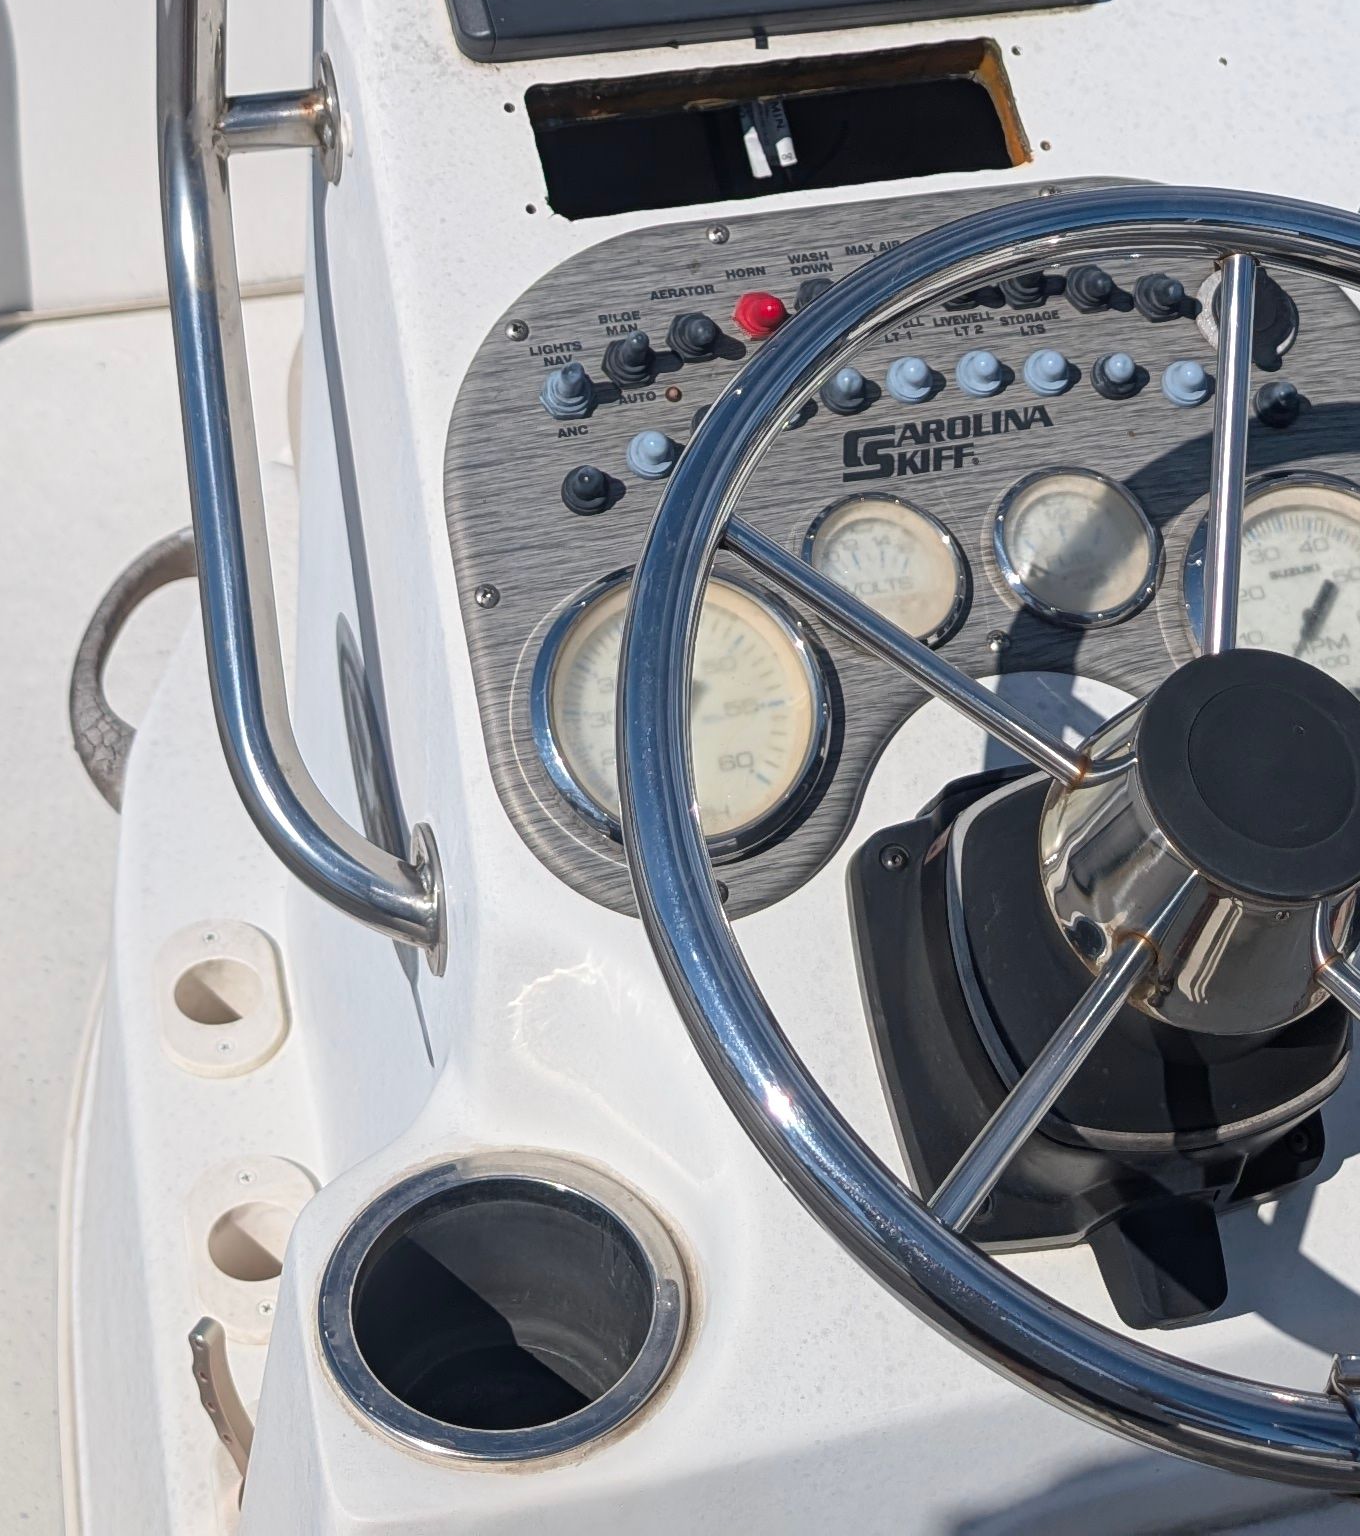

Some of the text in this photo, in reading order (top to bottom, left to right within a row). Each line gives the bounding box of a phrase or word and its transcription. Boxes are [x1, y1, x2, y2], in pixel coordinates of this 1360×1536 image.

[845, 242, 874, 256] MAX
[788, 251, 830, 265] WASH
[725, 265, 767, 281] HORN
[791, 262, 834, 277] DOWN
[649, 284, 717, 301] AERATOR
[598, 310, 641, 325] BILGE
[933, 311, 995, 328] LIVEWELL
[999, 310, 1061, 327] STORAGE
[606, 323, 639, 336] MAN
[953, 324, 985, 337] LT 2
[1019, 324, 1046, 337] LTS
[529, 340, 583, 357] LIGHTS
[543, 354, 573, 367] NAV
[618, 390, 657, 405] AUTO
[557, 424, 590, 438] ANC
[843, 405, 1054, 468] CAROLINA
[843, 438, 975, 482] SKIFF
[1269, 564, 1321, 581] SUZUKI
